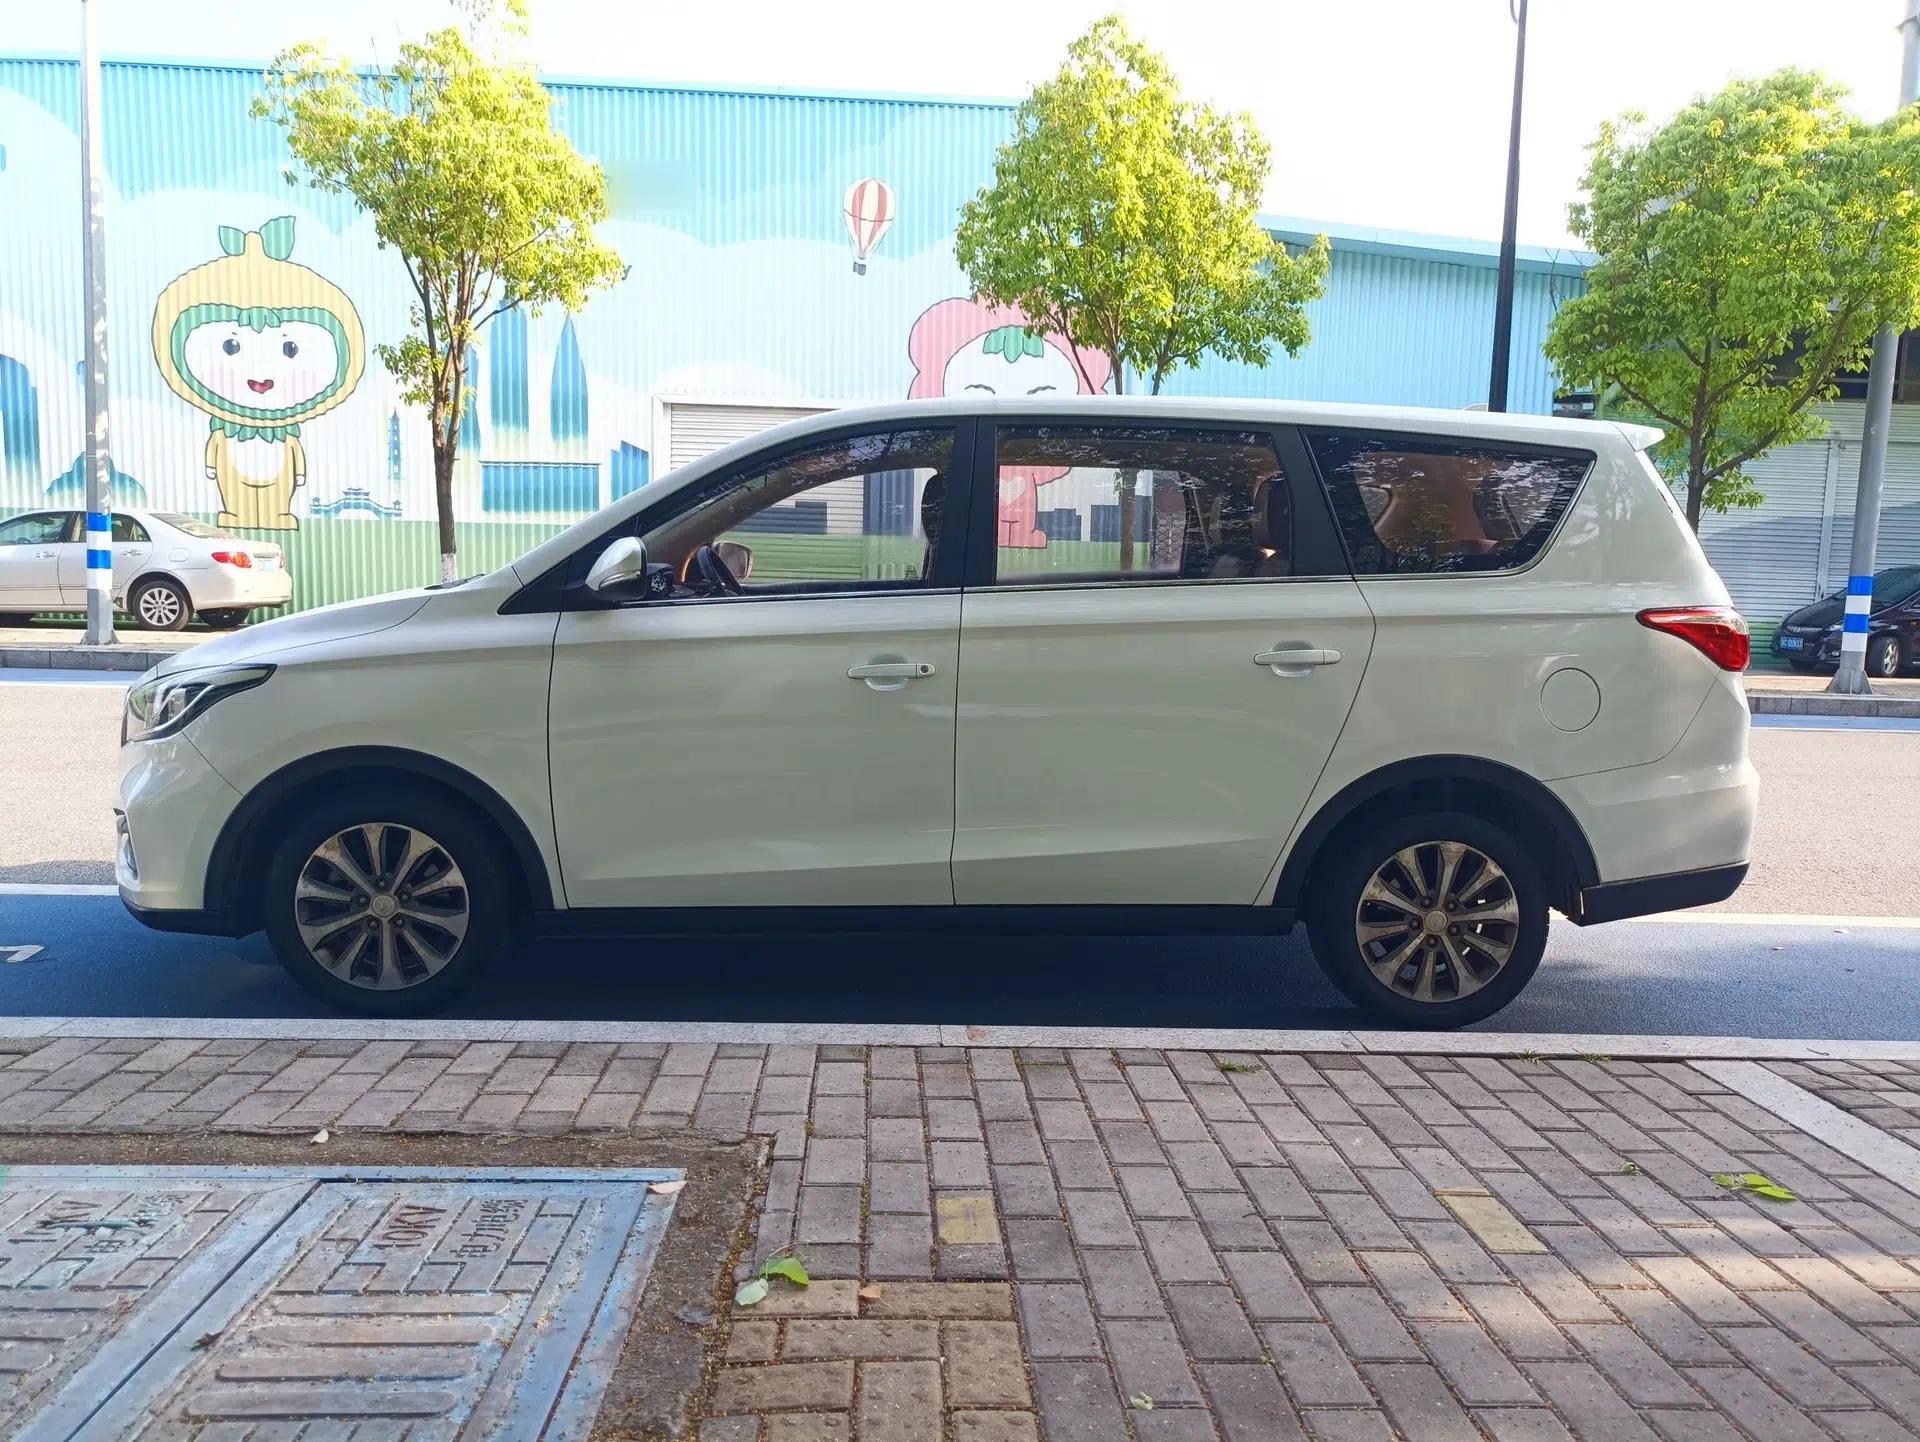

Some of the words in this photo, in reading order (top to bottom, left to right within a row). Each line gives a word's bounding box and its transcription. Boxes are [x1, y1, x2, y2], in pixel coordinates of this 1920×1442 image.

[372, 1205, 447, 1250] 10KV
[449, 1199, 529, 1258] 电力电缆
